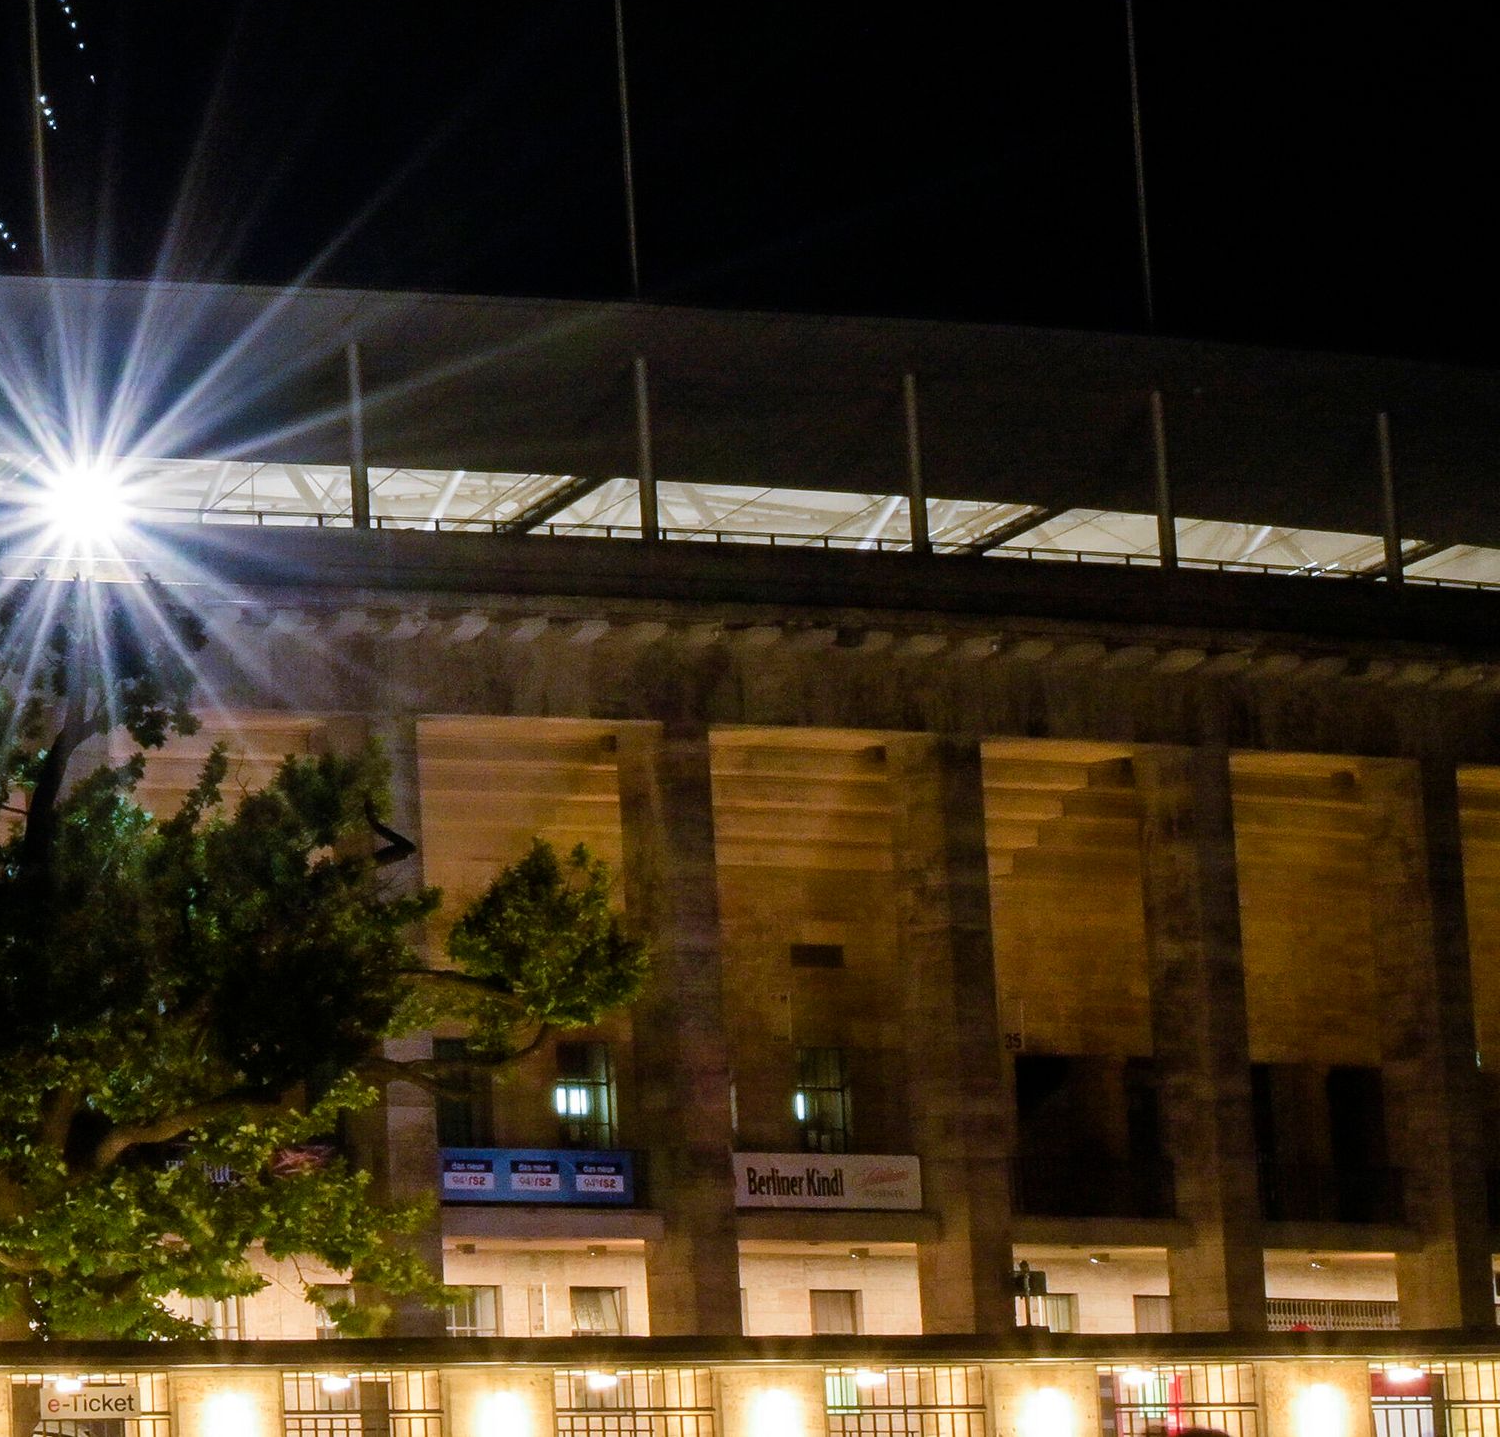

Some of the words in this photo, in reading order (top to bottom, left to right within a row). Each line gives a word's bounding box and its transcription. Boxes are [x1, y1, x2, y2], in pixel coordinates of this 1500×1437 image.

[746, 1167, 804, 1196] Berliner
[805, 1167, 844, 1197] Kindl
[48, 1393, 135, 1413] e-Ticket
